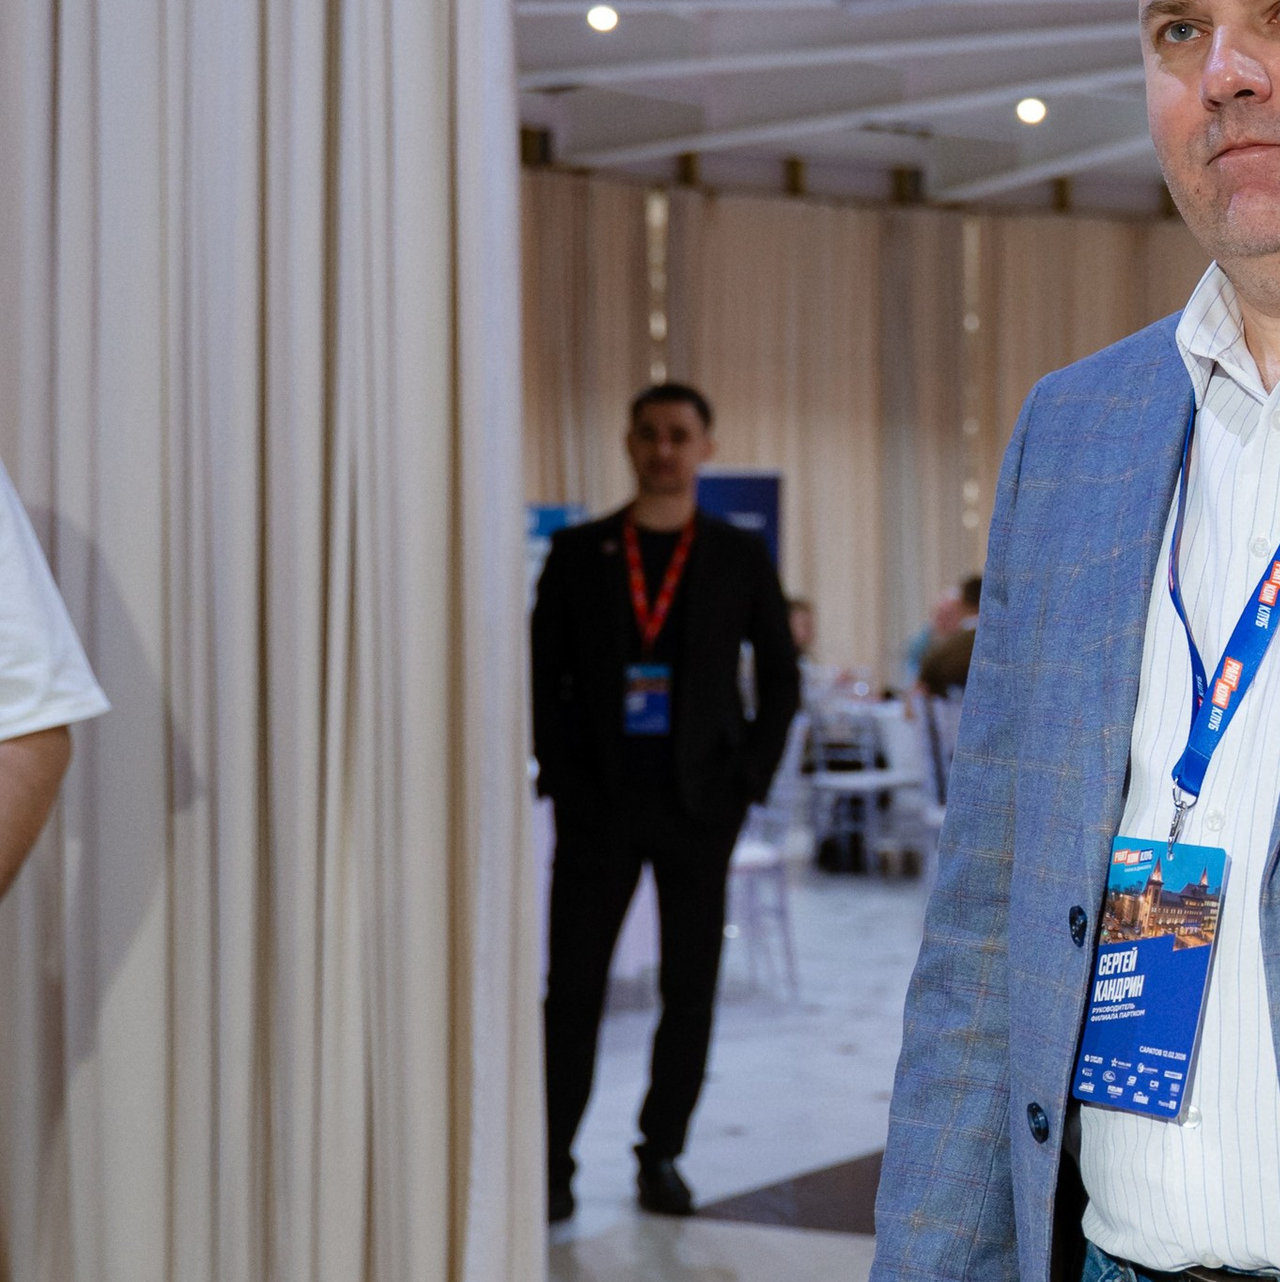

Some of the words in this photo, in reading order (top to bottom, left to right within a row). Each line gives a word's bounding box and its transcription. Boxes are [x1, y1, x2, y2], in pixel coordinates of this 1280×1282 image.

[1255, 604, 1271, 629] КЛУБ
[1223, 660, 1240, 688] PART
[1208, 706, 1224, 732] КЛУБ
[1098, 946, 1138, 976] СЕРГЕЙ
[1093, 974, 1145, 1003] КАНДРИН
[1090, 1013, 1119, 1022] ФИЛИАЛА
[1119, 1009, 1146, 1019] ПАРТКОМ
[1091, 1003, 1136, 1014] РУКОВОДИТЕЛЬ
